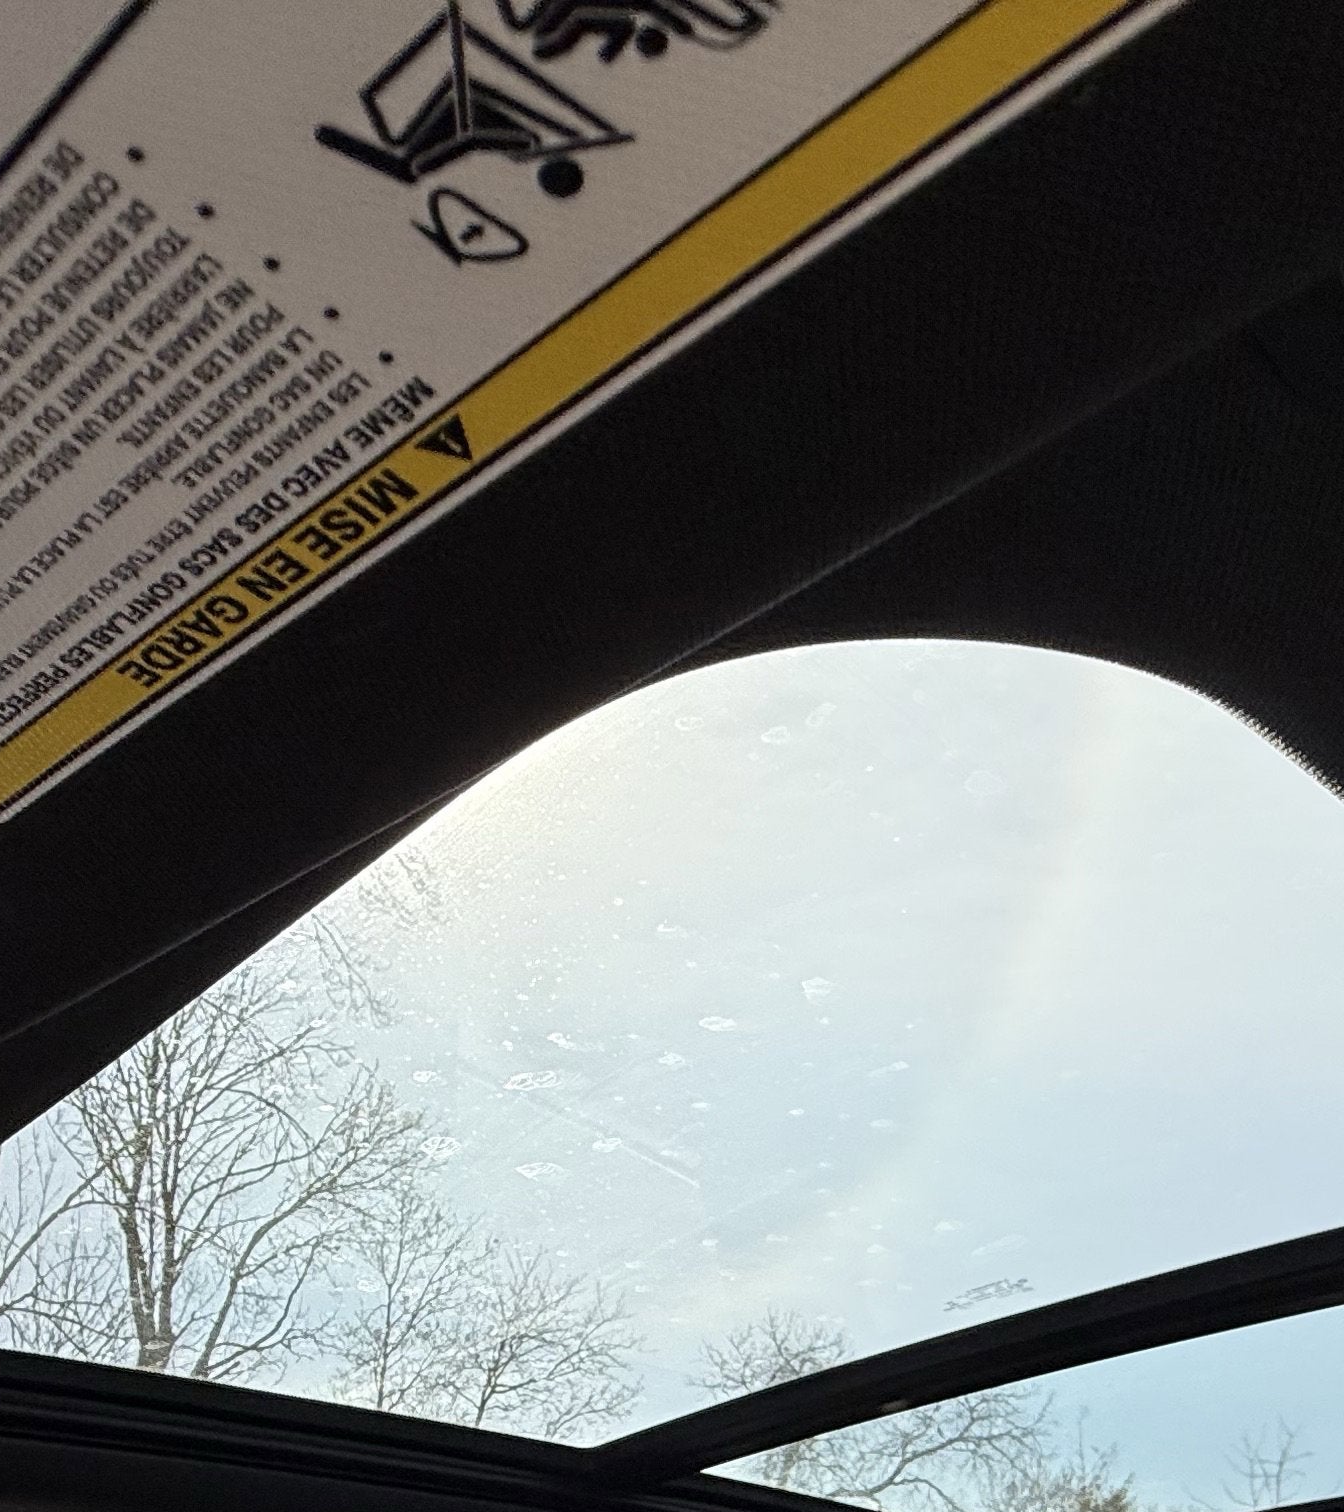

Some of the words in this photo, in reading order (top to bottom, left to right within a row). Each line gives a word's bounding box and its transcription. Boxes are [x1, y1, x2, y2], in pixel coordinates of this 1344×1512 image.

[37, 136, 87, 183] DE
[5, 166, 123, 288] CONSULTER
[112, 195, 159, 238] DE
[38, 224, 132, 316] RETENUE
[84, 221, 194, 326] TOUJOURS
[212, 276, 257, 315] NE
[112, 330, 150, 359] À
[148, 299, 230, 371] JAMAIS
[222, 300, 287, 356] POUR
[276, 324, 318, 359] LA
[187, 347, 236, 387] LES
[300, 347, 345, 383] UN
[91, 359, 169, 426] PLACER
[179, 347, 293, 442] BANQUETTE
[264, 373, 314, 413] SAC
[325, 369, 374, 408] LES
[27, 403, 70, 436] DU
[67, 415, 109, 448] UN
[247, 398, 338, 469] ENFANTS
[340, 375, 445, 455] MÊME
[116, 432, 199, 498] ARRIÈRE
[276, 438, 361, 501] AVEC
[87, 486, 132, 520] EST
[177, 460, 262, 525] PEUVENT
[230, 489, 294, 535] DES
[288, 466, 424, 562] MISE
[68, 510, 105, 536] LA
[143, 516, 198, 556] ÊTRE
[26, 527, 85, 573] PLACE
[106, 546, 162, 586] TUÉS
[174, 525, 249, 579] SACS
[9, 565, 43, 587] LA
[85, 575, 121, 600] OU
[230, 547, 314, 604] EN
[54, 569, 193, 670] GONFLABLES
[113, 591, 258, 689] GARDE
